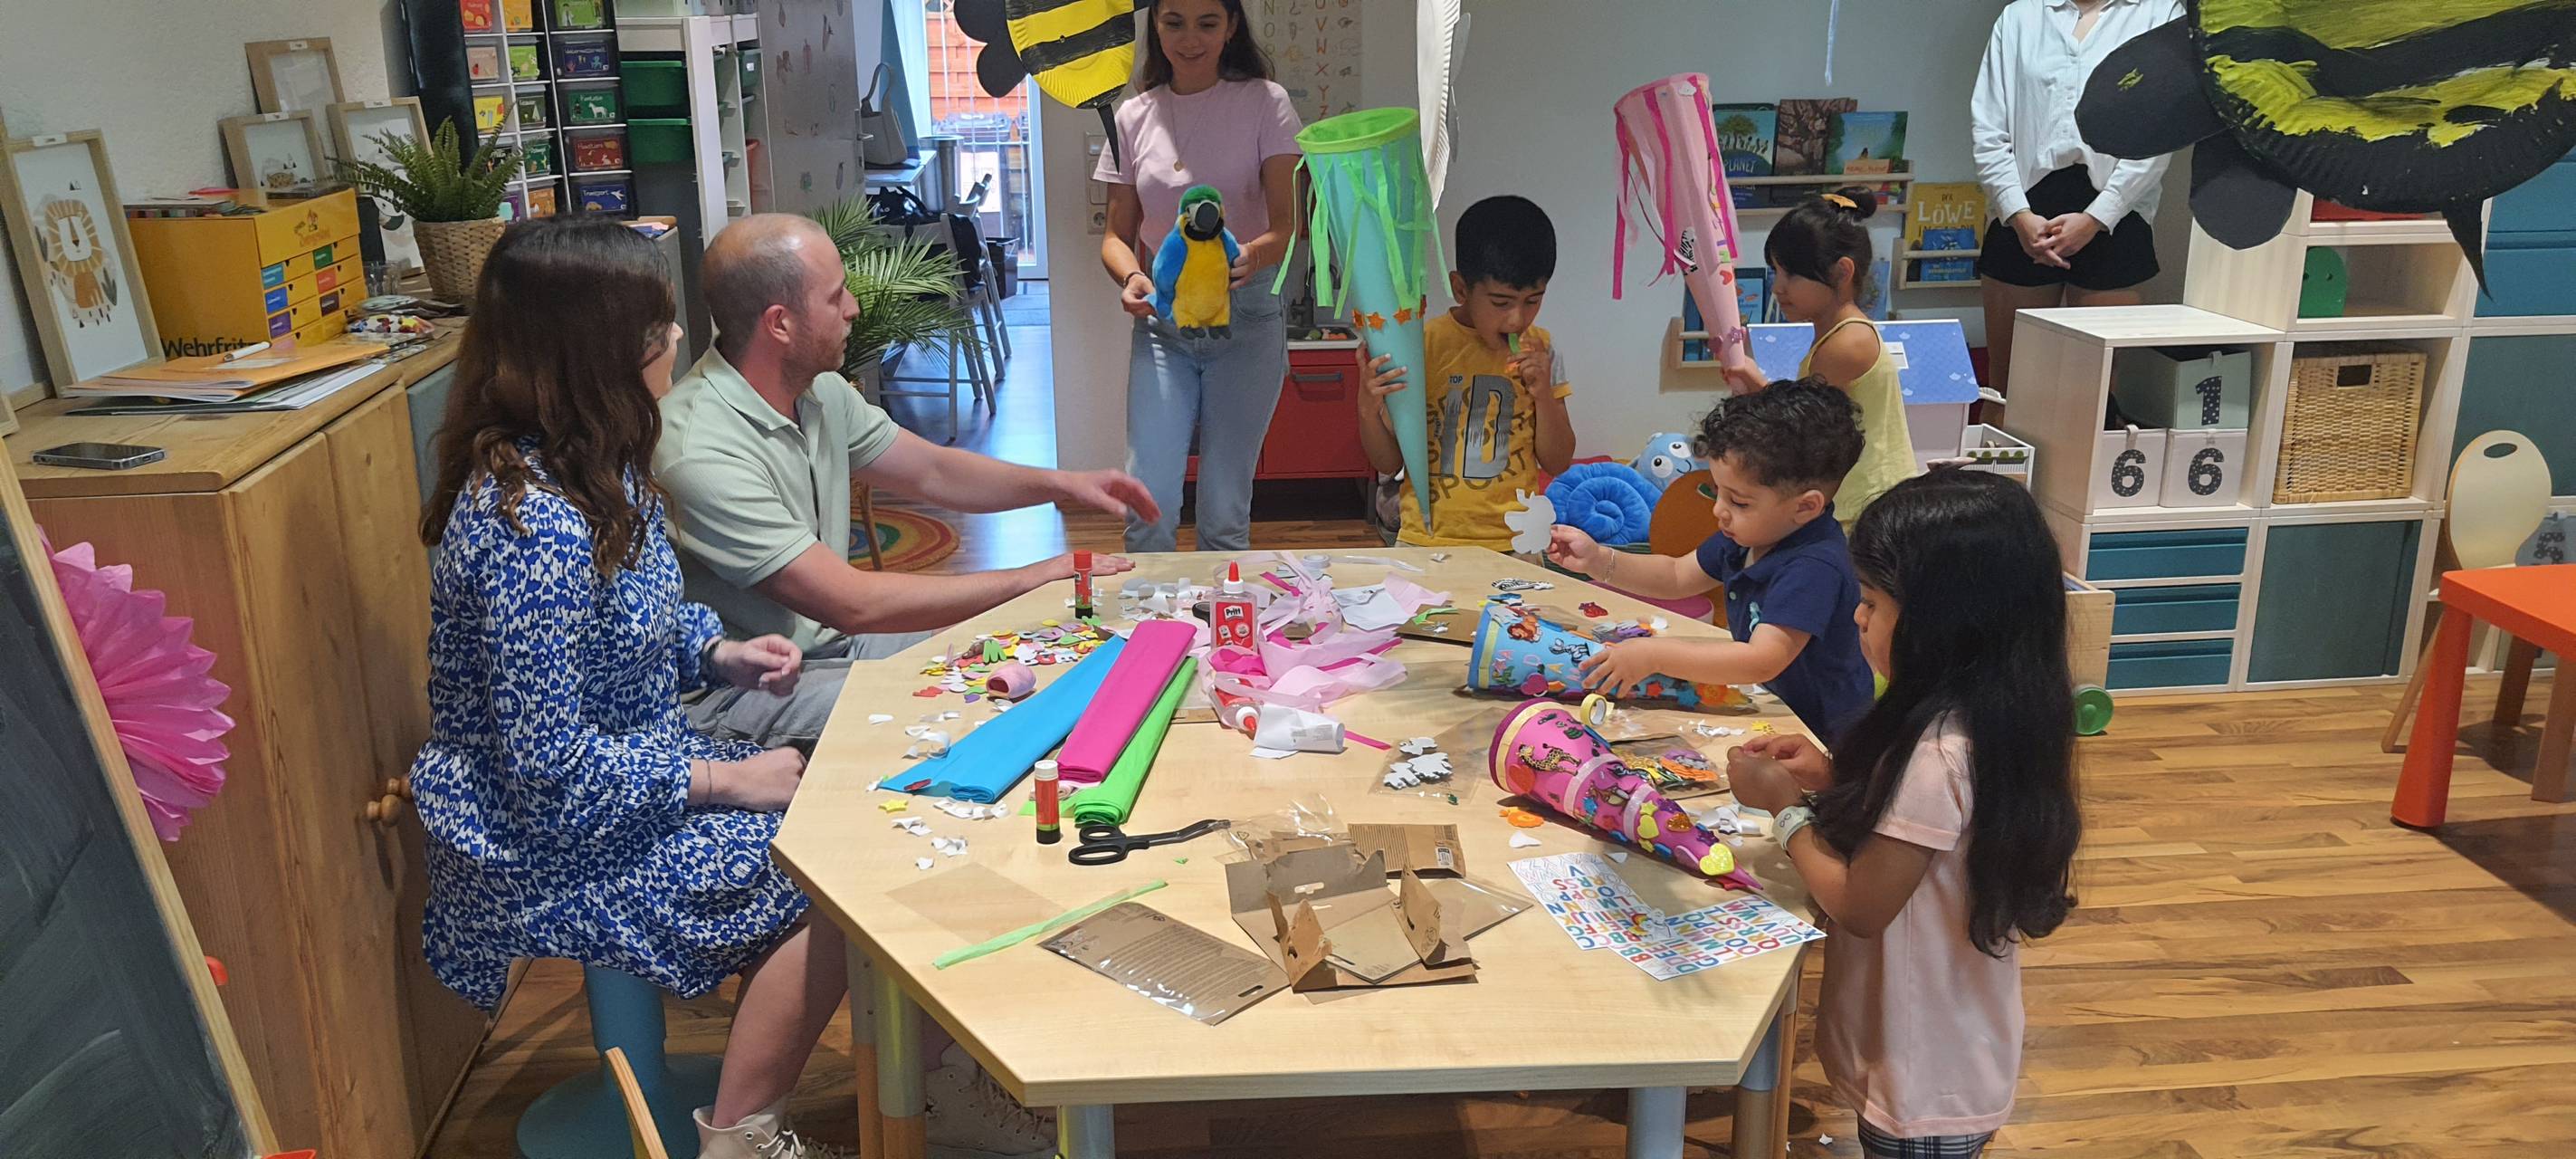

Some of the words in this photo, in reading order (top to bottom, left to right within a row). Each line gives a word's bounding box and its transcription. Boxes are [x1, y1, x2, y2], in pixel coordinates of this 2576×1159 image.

[1264, 22, 1275, 38] O
[1315, 16, 1328, 33] V
[1316, 38, 1328, 54] W
[1315, 62, 1330, 76] X
[1318, 85, 1330, 101] Y
[1917, 201, 1977, 225] LÖWE
[160, 337, 259, 358] Wehrfrit
[2195, 376, 2222, 426] 1
[2111, 449, 2146, 497] 6
[2188, 448, 2224, 495] 6
[1226, 608, 1241, 616] Pritt
